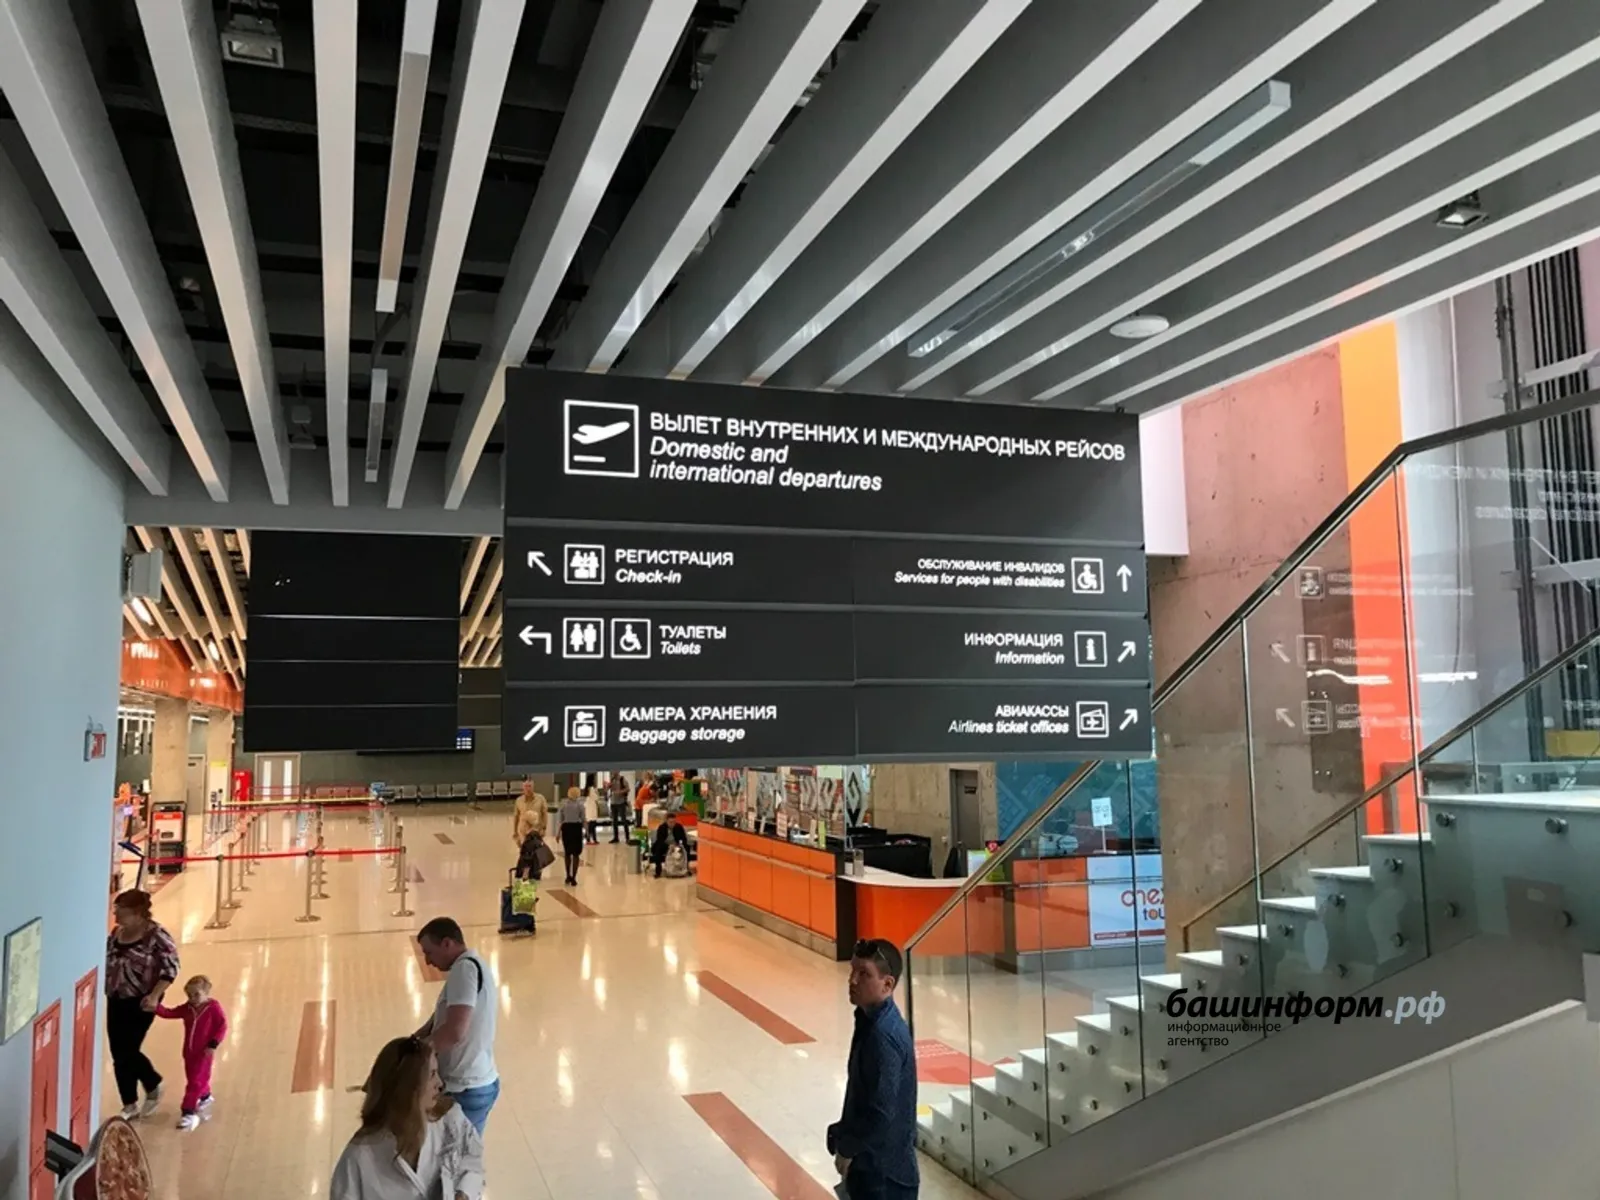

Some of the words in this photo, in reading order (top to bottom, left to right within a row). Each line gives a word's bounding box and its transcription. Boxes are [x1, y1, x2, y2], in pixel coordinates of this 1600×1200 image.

[651, 412, 722, 434] ВЫЛЕТ
[727, 416, 859, 445] ВНУТРЕННИХ
[864, 428, 876, 445] И
[882, 429, 1051, 457] МЕЖДУНАРОДНЫХ
[1055, 439, 1126, 461] РЕЙСОВ
[651, 435, 745, 461] Domestic
[751, 444, 789, 462] and
[650, 459, 774, 485] international
[779, 468, 882, 491] departures
[615, 549, 733, 567] РЕГИСТРАЦИЯ
[918, 558, 1002, 572] ОБСЛУЖИВАНИЕ
[1003, 560, 1065, 575] ИНВАЛИДОВ
[615, 568, 681, 583] Check-in
[895, 571, 939, 584] Services
[940, 573, 955, 584] for
[956, 574, 990, 587] people
[993, 575, 1013, 586] with
[1014, 576, 1065, 588] disabilities
[659, 625, 726, 639] ТУАЛЕТЫ
[661, 641, 701, 654] Toilets
[965, 633, 1064, 649] ИНФОРМАЦИЯ
[995, 651, 1065, 665] Information
[619, 707, 686, 721] КАМЕРА
[690, 705, 776, 720] ХРАНЕНИЯ
[995, 705, 1069, 717] АВИАКАССЫ
[948, 720, 994, 733] Airlines
[996, 720, 1029, 733] ticket
[1030, 720, 1069, 733] offices
[619, 727, 686, 744] Baggage
[690, 727, 745, 742] storage
